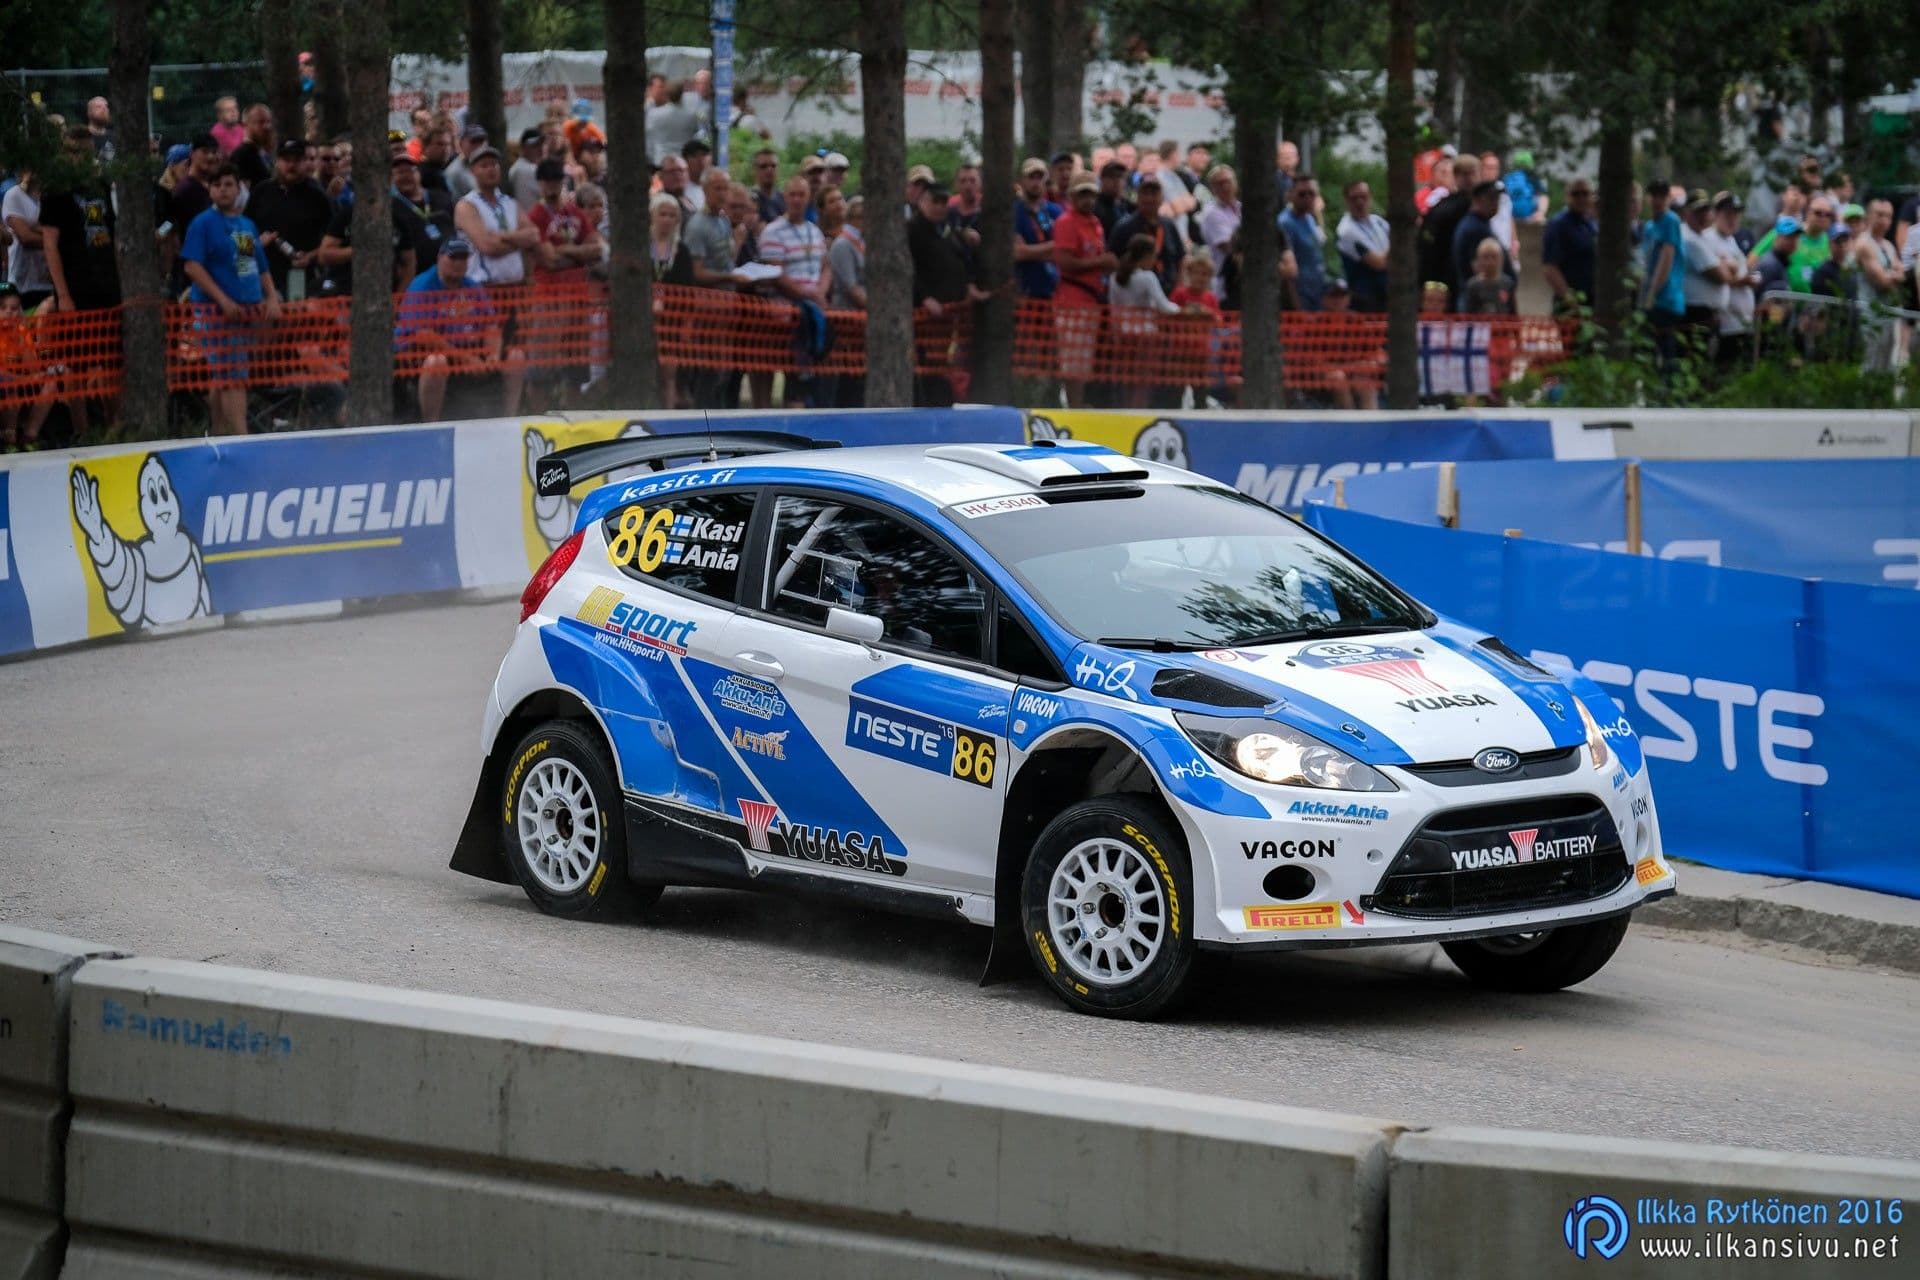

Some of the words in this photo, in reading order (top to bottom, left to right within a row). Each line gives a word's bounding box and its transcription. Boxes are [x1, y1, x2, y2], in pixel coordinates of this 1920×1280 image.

[619, 469, 738, 502] kasit.fi
[202, 478, 452, 547] MICHELIN
[962, 498, 1042, 515] HK-5040
[609, 505, 675, 572] 86
[691, 517, 746, 543] Kasi
[682, 544, 739, 571] Ania
[607, 601, 698, 648] sport
[713, 679, 786, 716] Akku-Ania
[1394, 693, 1499, 713] YUASA
[1529, 649, 1829, 786] STE
[953, 735, 996, 784] 86
[1486, 752, 1512, 768] Ford
[505, 740, 548, 825] SCORPION
[1288, 801, 1390, 820] Akku-Ania
[778, 820, 893, 873] YUASA
[1451, 846, 1518, 871] YUASA
[1535, 834, 1598, 861] BATTERY
[1122, 823, 1182, 939] SCORPION
[1249, 905, 1335, 928] PIRELLI
